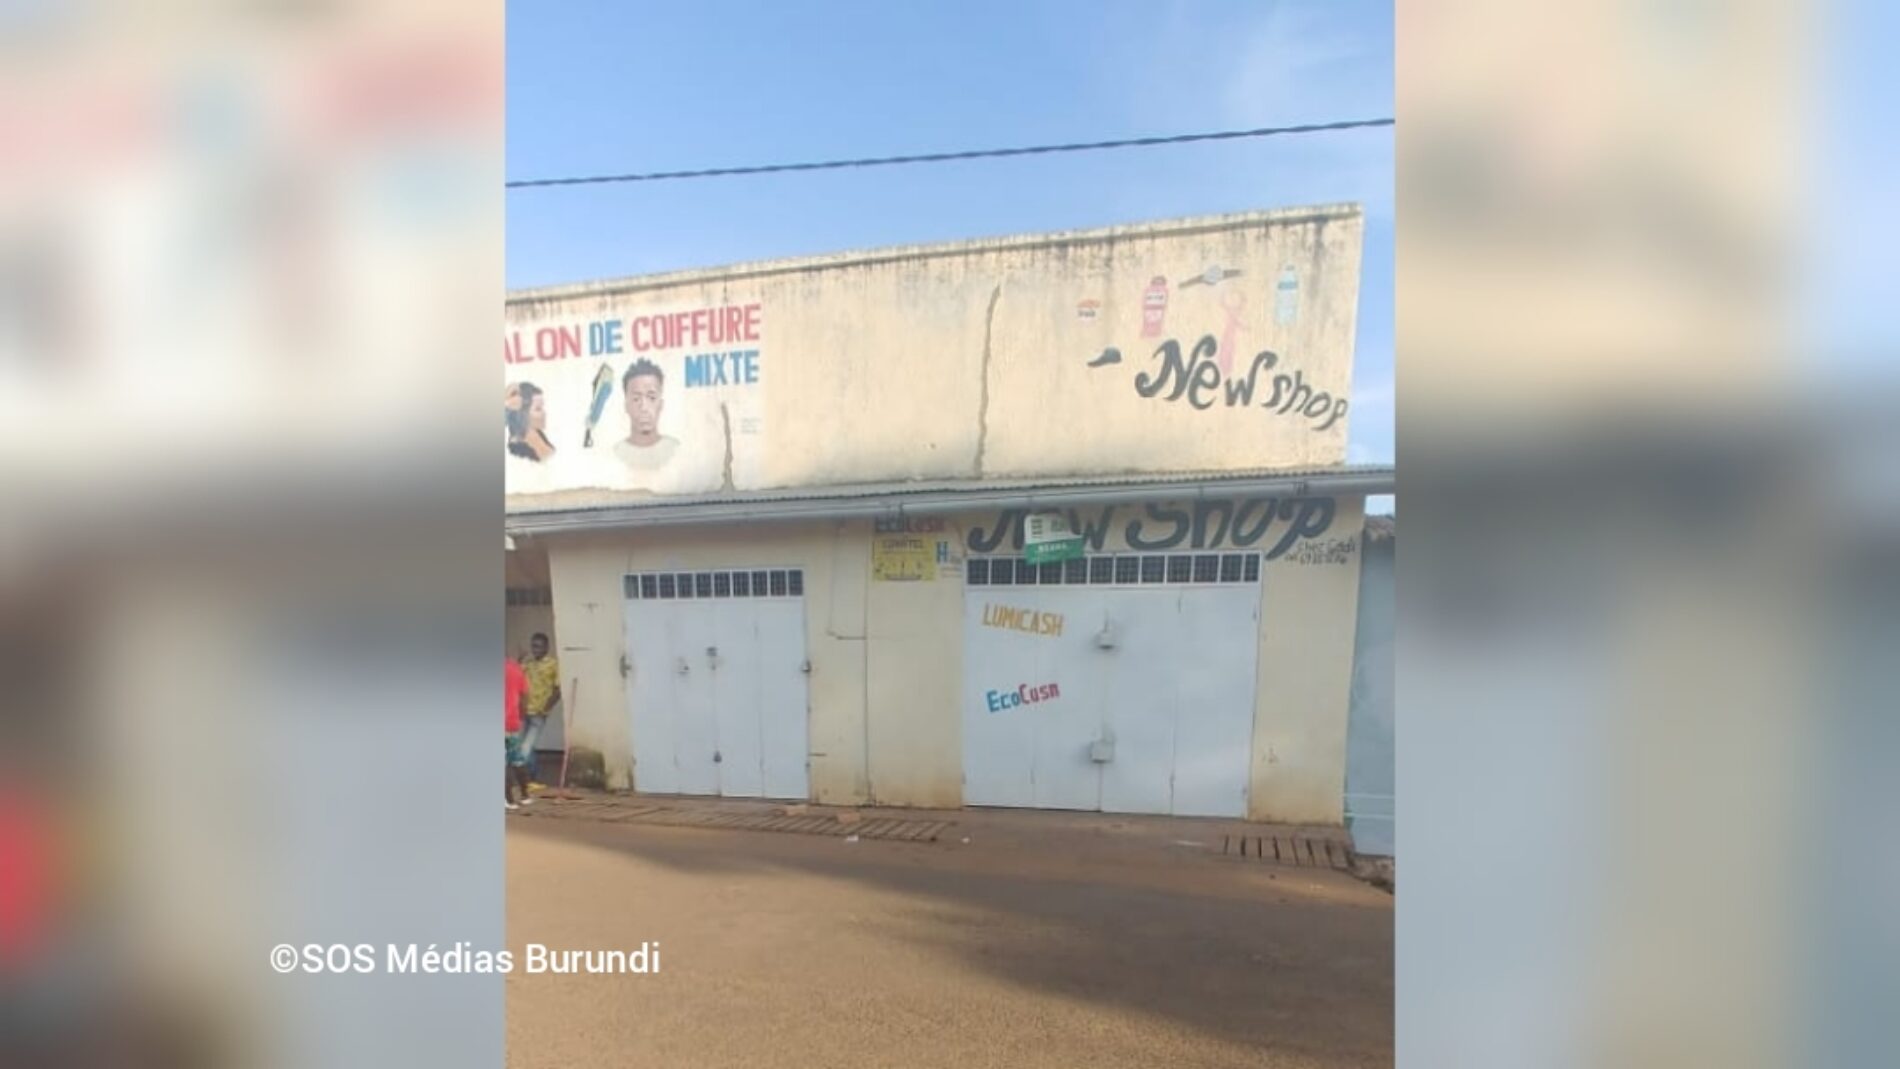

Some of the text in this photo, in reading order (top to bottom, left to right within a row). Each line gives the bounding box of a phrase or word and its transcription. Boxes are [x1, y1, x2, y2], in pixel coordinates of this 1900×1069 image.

[588, 320, 623, 356] DE
[631, 304, 761, 352] COIFFURE
[684, 350, 760, 388] MIXTE
[1134, 334, 1278, 410] New
